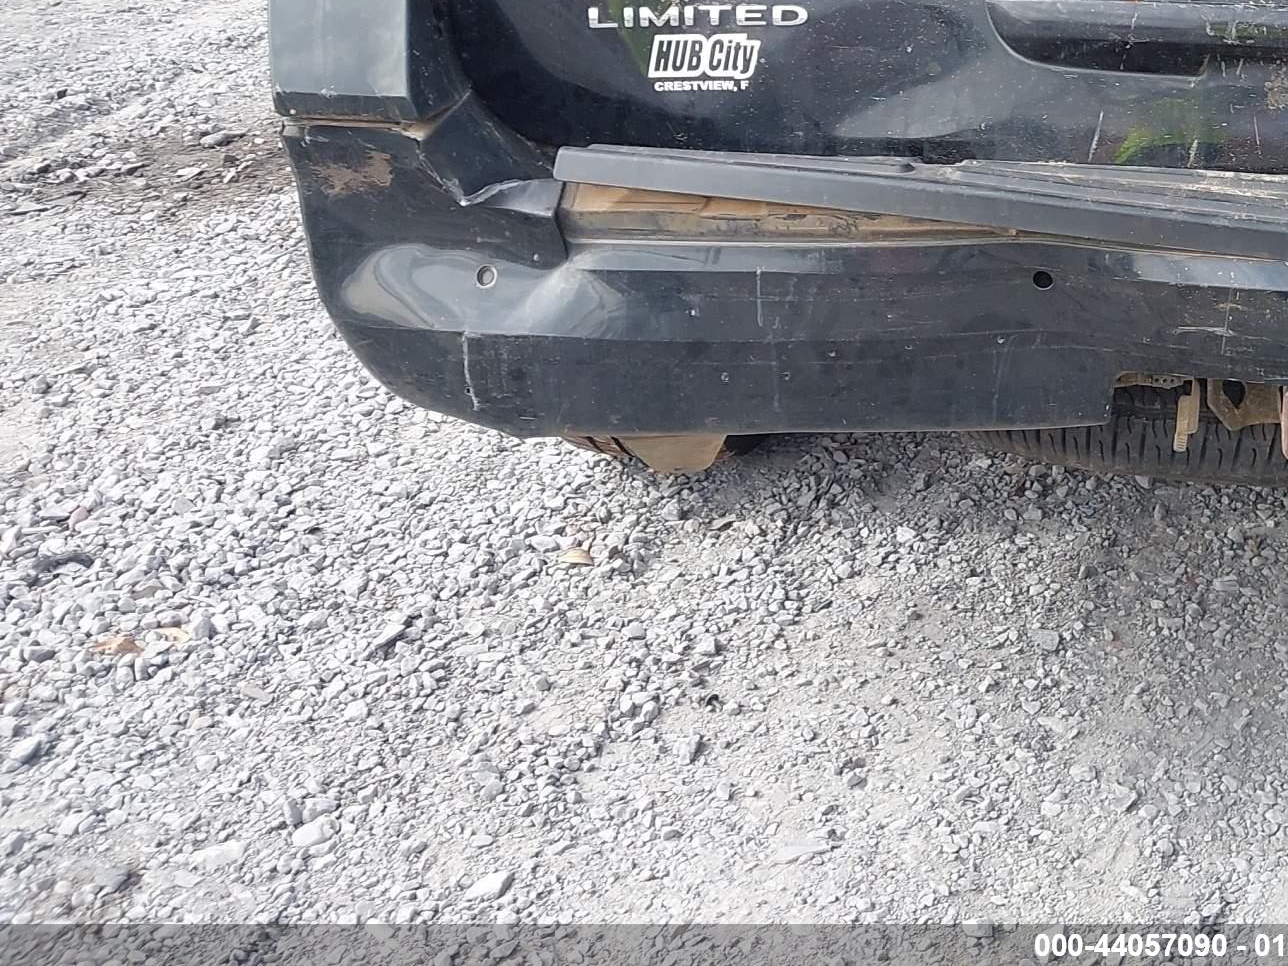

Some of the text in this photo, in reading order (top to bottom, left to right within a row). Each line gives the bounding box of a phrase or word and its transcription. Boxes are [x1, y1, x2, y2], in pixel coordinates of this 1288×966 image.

[587, 4, 809, 29] LIMITED
[654, 39, 755, 75] HUB City
[653, 81, 738, 92] CRESTVIEW,
